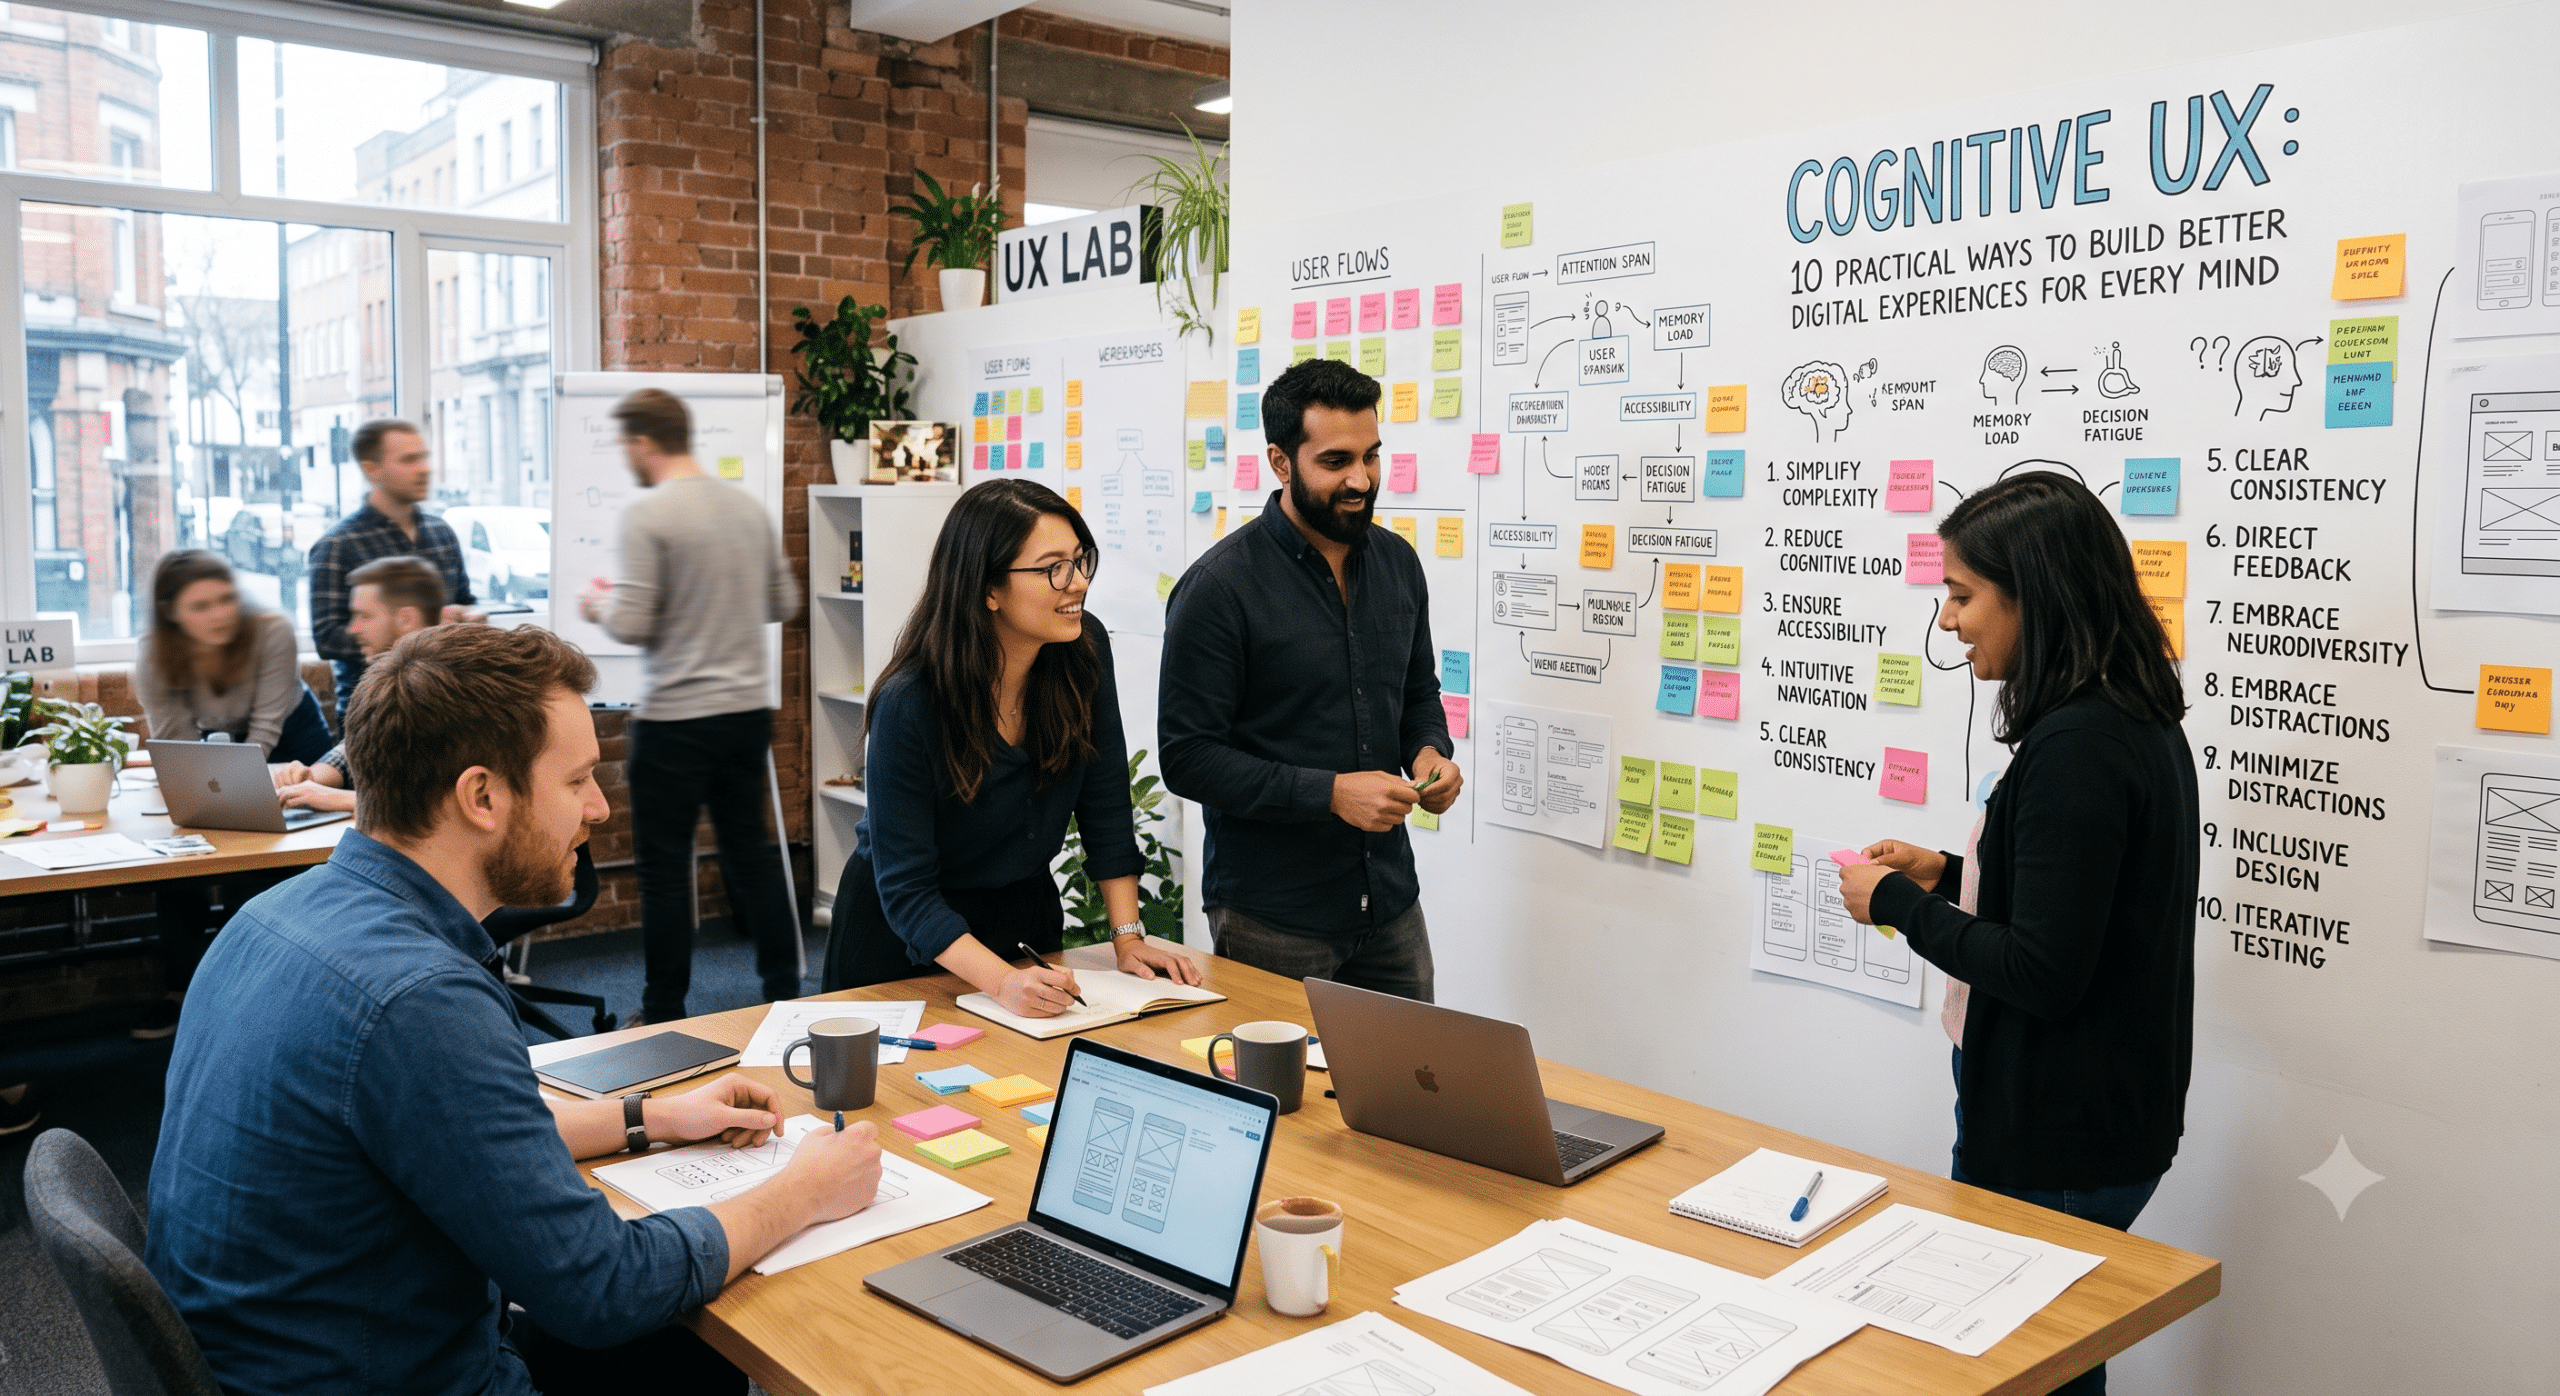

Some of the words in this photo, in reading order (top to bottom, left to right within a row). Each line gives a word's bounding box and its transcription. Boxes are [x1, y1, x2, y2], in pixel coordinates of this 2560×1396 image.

[1786, 108, 2112, 244] COGNITIVE
[2150, 84, 2299, 196] UX:
[1005, 236, 1048, 292] UX
[1062, 221, 1132, 283] LAB
[1562, 257, 1616, 275] ATTENTION
[1623, 253, 1649, 268] SPAN
[1792, 259, 1822, 294] 10
[1837, 249, 1955, 287] PRACTICAL
[1968, 239, 2032, 271] WAYS
[2046, 234, 2076, 262] TO
[2091, 224, 2164, 258] BUILD
[2180, 209, 2287, 249] BETTER
[1293, 256, 1329, 282] USER
[1339, 247, 1388, 276] FLOWS
[1492, 274, 1509, 284] USER
[1793, 299, 1868, 329] DIGITAL
[1880, 280, 2027, 320] EXPERIENCES
[2043, 274, 2087, 304] FOR
[2102, 263, 2184, 298] EVERY
[2199, 256, 2279, 290] MIND
[1659, 312, 1704, 327] MEMORY
[1668, 329, 1693, 341] LOAD
[1590, 348, 1615, 360] USER
[1625, 401, 1691, 413] ACCESSIBILITY
[1892, 399, 1924, 411] SPAN
[2083, 409, 2148, 423] DECISION
[1974, 413, 2031, 427] MEMORY
[1986, 432, 2019, 445] LOAD
[2085, 427, 2143, 441] FATIGUE
[1647, 465, 1689, 476] DECISION
[1768, 462, 1779, 481] 1.
[1787, 461, 1861, 480] SIMPLIFY
[2208, 448, 2226, 472] 5.
[2236, 448, 2309, 471] CLEAR
[1648, 481, 1686, 493] FATIGUE
[1783, 488, 1878, 508] COMPLEXITY
[2231, 479, 2386, 504] CONSISTENCY
[1493, 530, 1553, 542] ACCESSIBILITY
[1632, 534, 1671, 546] DECISION
[1676, 536, 1712, 548] FATIGUE
[1765, 527, 1778, 546] 2.
[1785, 529, 1843, 548] REDUCE
[2207, 524, 2225, 547] 6.
[2236, 526, 2318, 550] DIRECT
[1781, 554, 1856, 574] COGNITIVE
[1863, 557, 1902, 576] LOAD
[2234, 555, 2351, 581] FEEDBACK
[1763, 592, 1776, 612] 3.
[1783, 594, 1841, 616] ENSURE
[2207, 601, 2222, 623] 7.
[2233, 603, 2339, 630] EMBRACE
[1778, 620, 1886, 646] ACCESSIBILITY
[9, 647, 54, 664] LAB
[2228, 633, 2408, 667] NEURODIVERSITY
[1762, 657, 1774, 676] 4.
[1781, 660, 1853, 684] INTUITIVE
[1778, 685, 1866, 711] NAVIGATION
[2205, 672, 2223, 696] 8.
[2232, 676, 2336, 706] EMBRACE
[1760, 721, 1773, 742] 5.
[1779, 725, 1827, 748] CLEAR
[2231, 705, 2389, 742] DISTRACTIONS
[1775, 750, 1875, 780] CONSISTENCY
[2230, 750, 2340, 784] MINIMIZE
[2228, 778, 2385, 820] DISTRACTIONS
[2204, 823, 2222, 847] 9.
[2233, 827, 2349, 867] INCLUSIVE
[2236, 857, 2319, 892] DESIGN
[2198, 896, 2226, 922] 10.
[2236, 902, 2350, 945] ITERATIVE
[2230, 930, 2326, 969] TESTING
